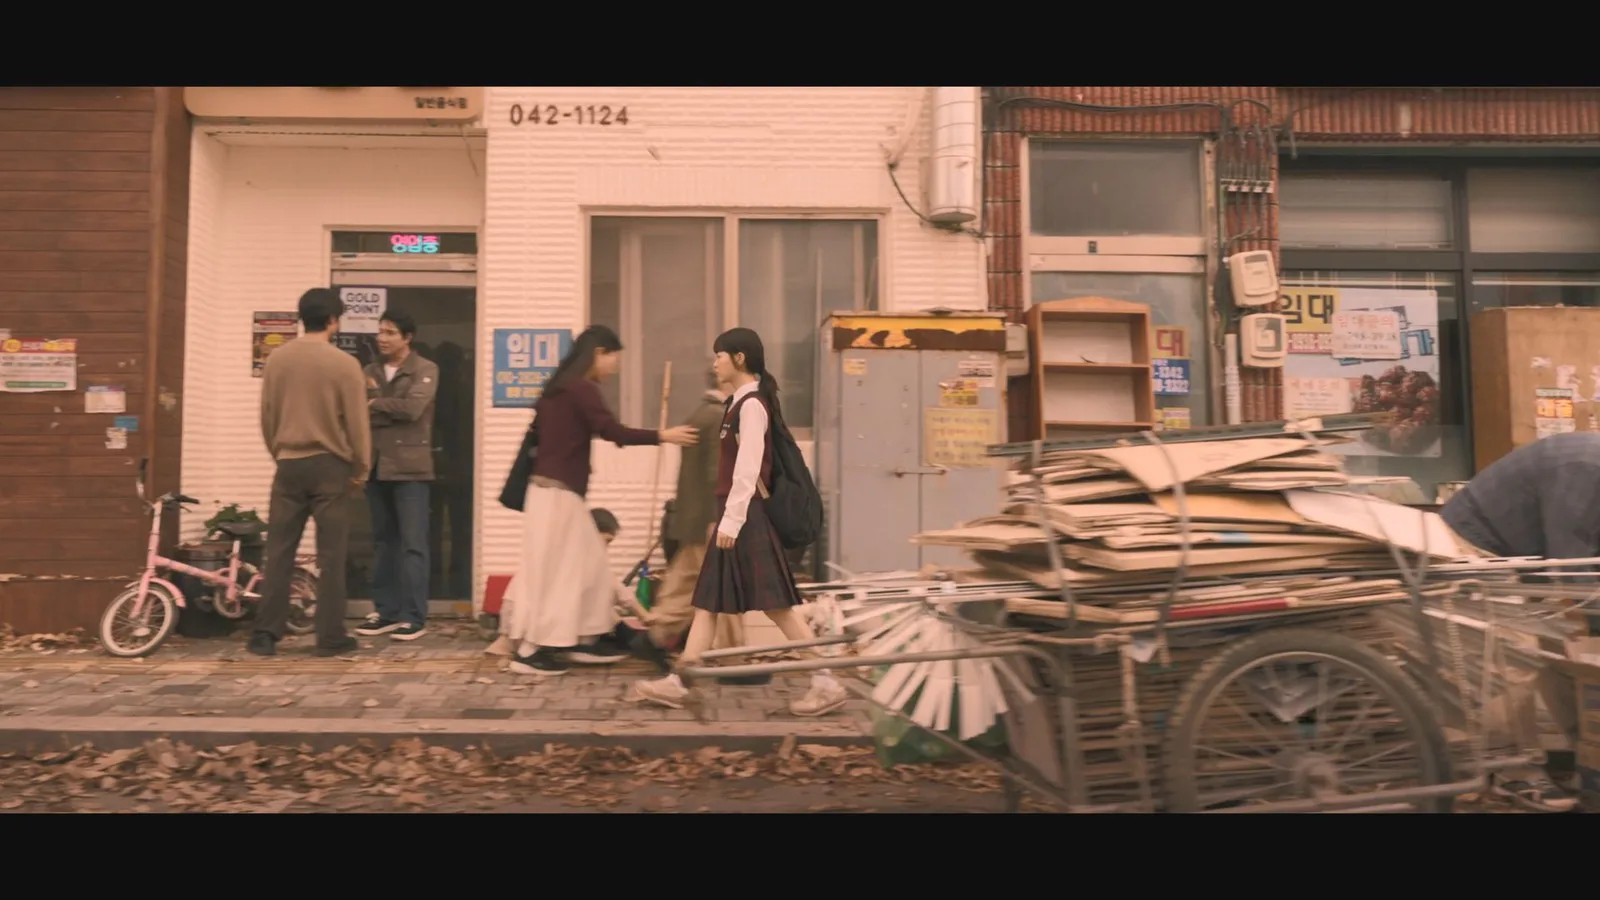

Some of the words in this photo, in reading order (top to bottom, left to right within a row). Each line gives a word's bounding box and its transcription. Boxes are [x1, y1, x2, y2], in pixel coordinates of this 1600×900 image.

[509, 104, 629, 125] 042-1124
[390, 234, 440, 254] 영업중
[346, 292, 380, 303] GOLD
[344, 304, 380, 315] POINT
[1281, 294, 1333, 324] 임대
[506, 332, 560, 368] 임대
[1156, 329, 1184, 357] 대
